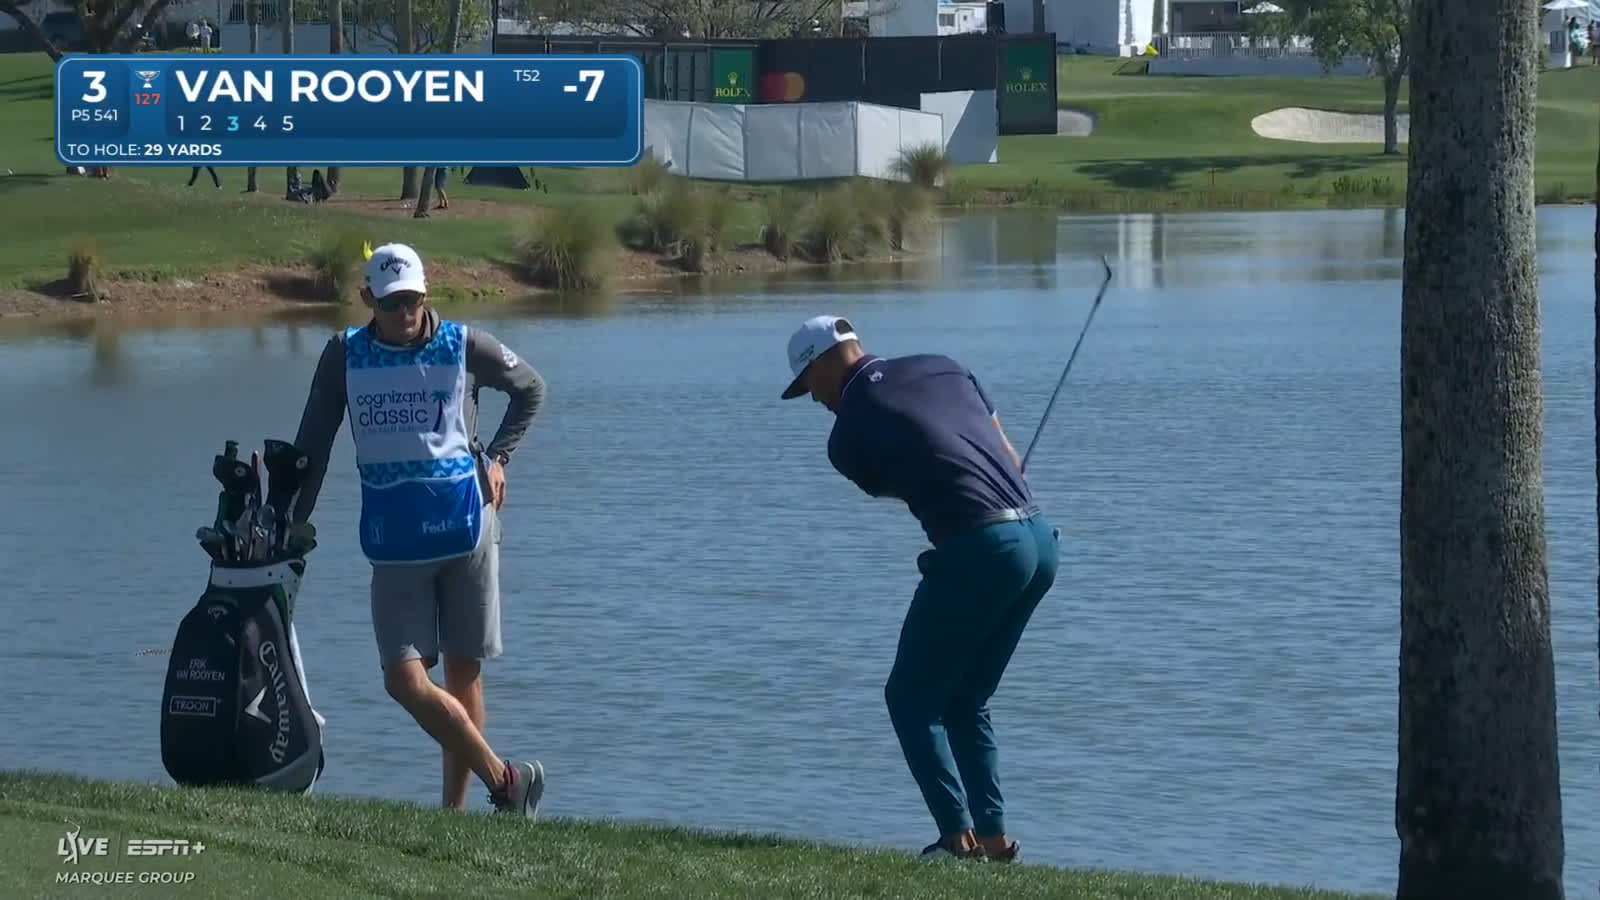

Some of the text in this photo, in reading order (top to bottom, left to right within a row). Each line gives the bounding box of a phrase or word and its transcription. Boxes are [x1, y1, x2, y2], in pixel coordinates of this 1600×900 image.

[715, 86, 751, 98] ROLEX
[1005, 81, 1048, 94] ROLEX
[356, 389, 427, 409] cognizant
[359, 403, 429, 427] classic
